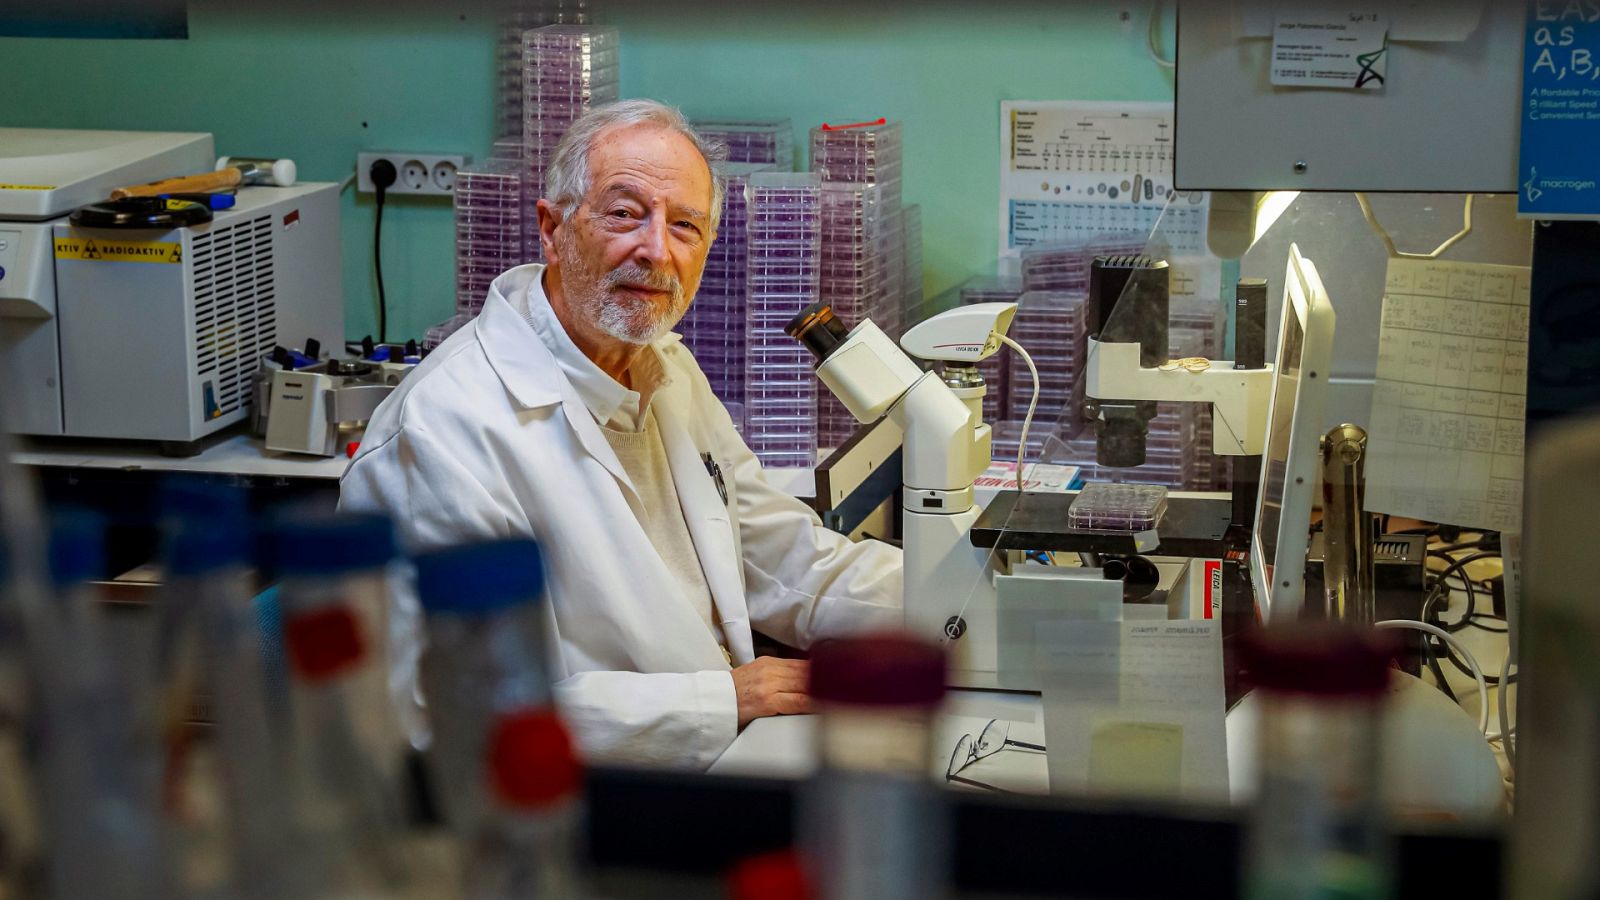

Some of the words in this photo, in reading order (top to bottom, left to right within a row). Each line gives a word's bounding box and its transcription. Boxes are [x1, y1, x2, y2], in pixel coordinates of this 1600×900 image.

[1534, 26, 1575, 46] as
[1540, 180, 1596, 191] macrogen
[57, 244, 80, 253] KTIV
[103, 246, 165, 256] RADIOAKTIV
